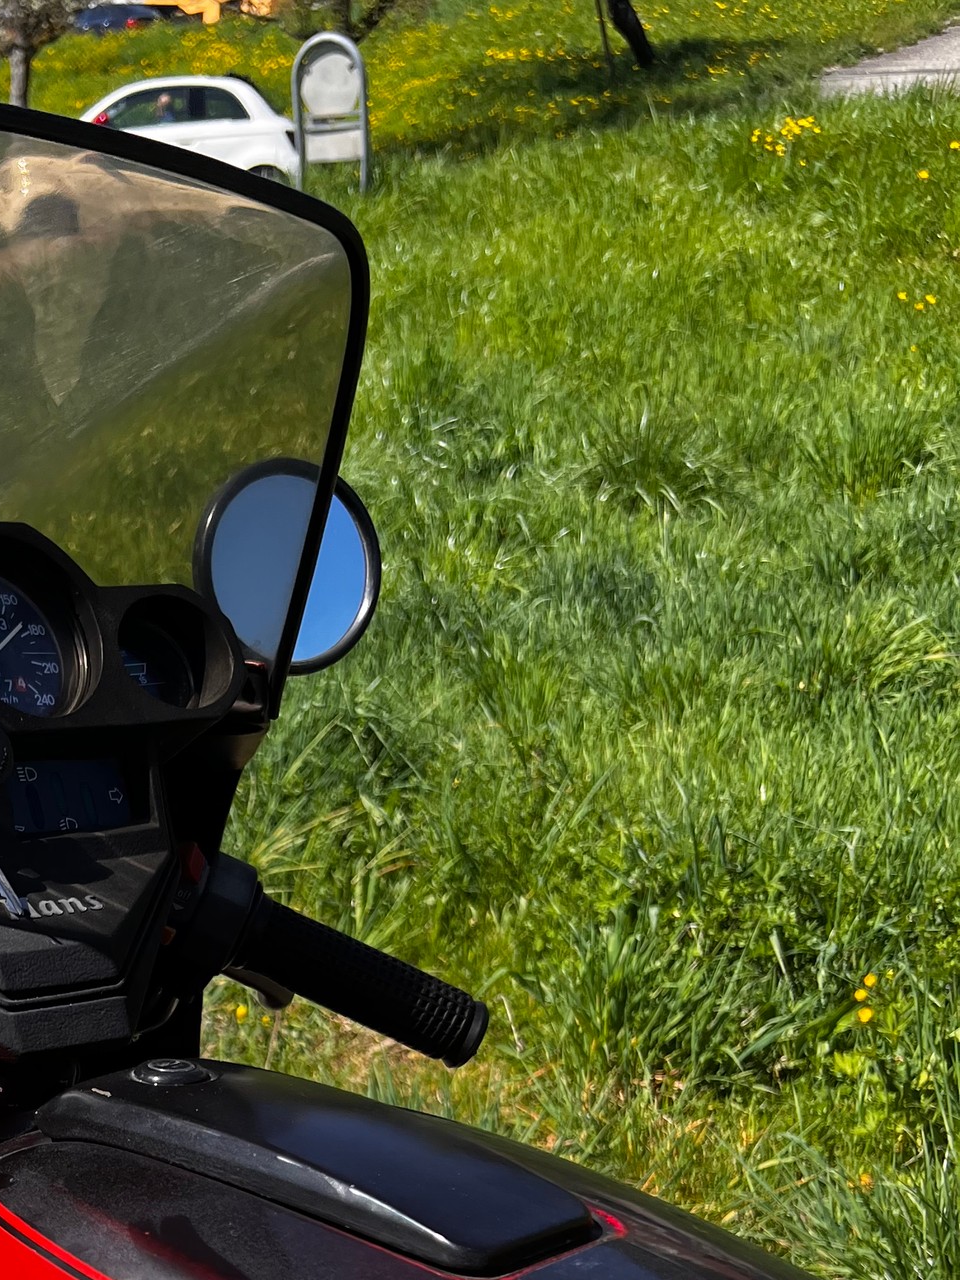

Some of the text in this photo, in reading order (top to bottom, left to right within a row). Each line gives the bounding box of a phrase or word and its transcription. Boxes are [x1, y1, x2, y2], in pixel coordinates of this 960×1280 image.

[0, 594, 18, 606] 150
[27, 624, 46, 636] 180
[42, 663, 59, 675] 210
[34, 693, 56, 706] 240
